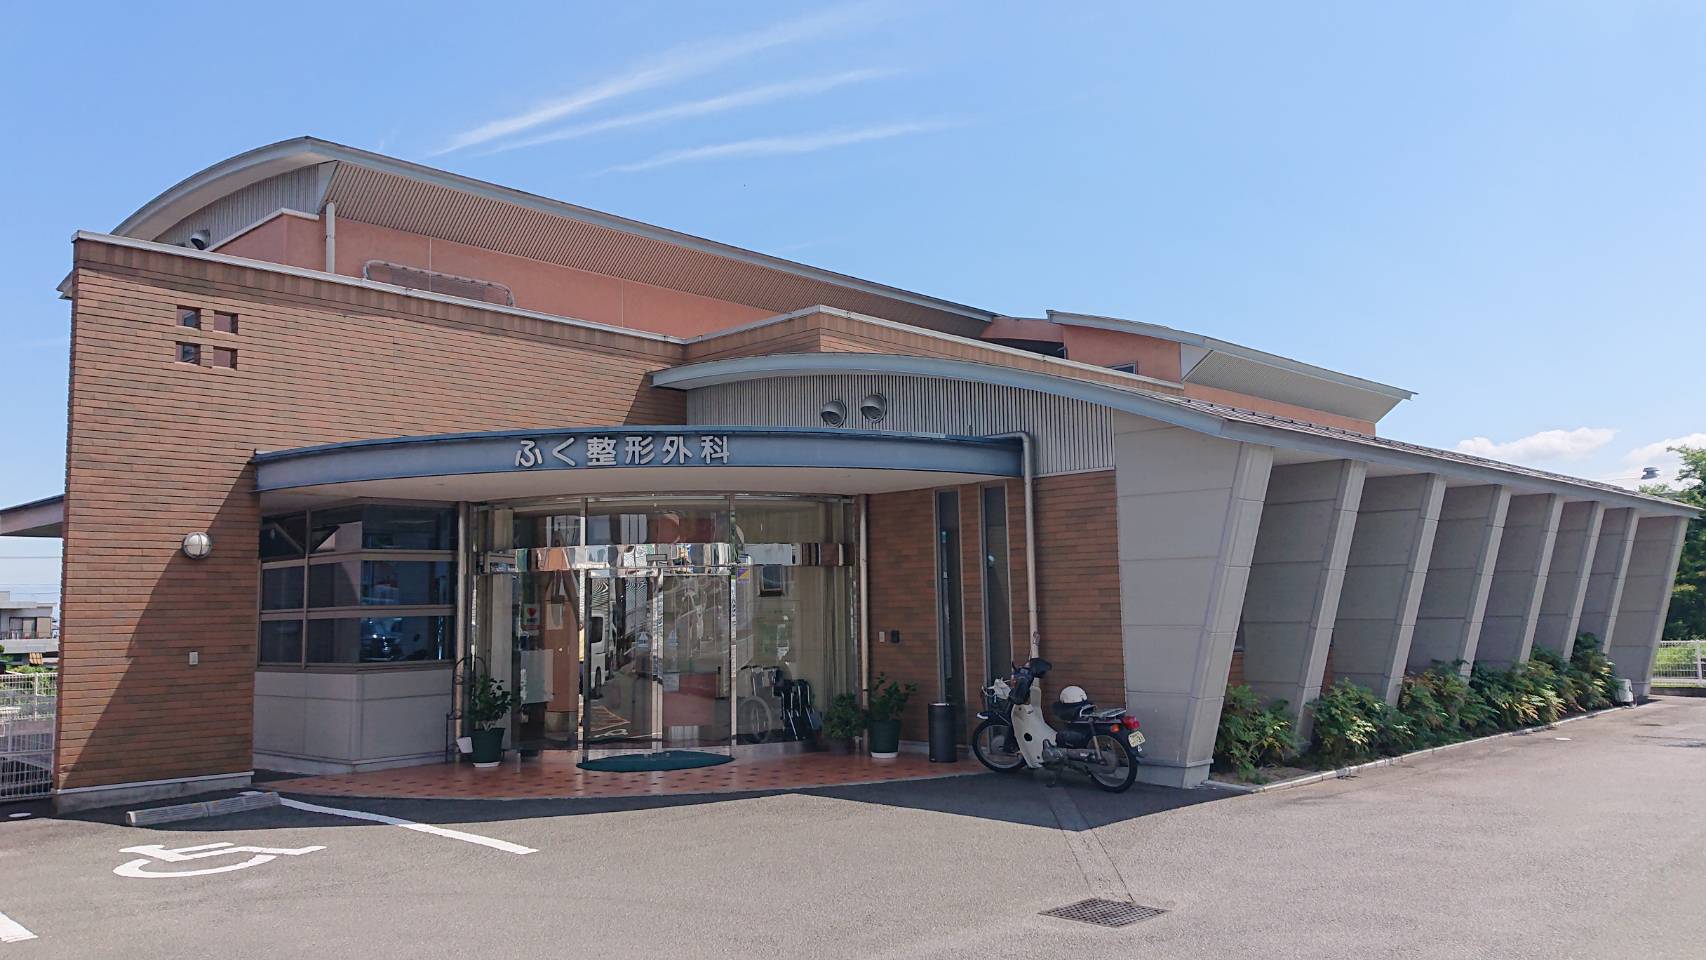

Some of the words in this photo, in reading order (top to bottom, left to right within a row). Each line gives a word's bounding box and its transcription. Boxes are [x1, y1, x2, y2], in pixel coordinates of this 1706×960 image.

[514, 435, 730, 467] ふく整形外科
